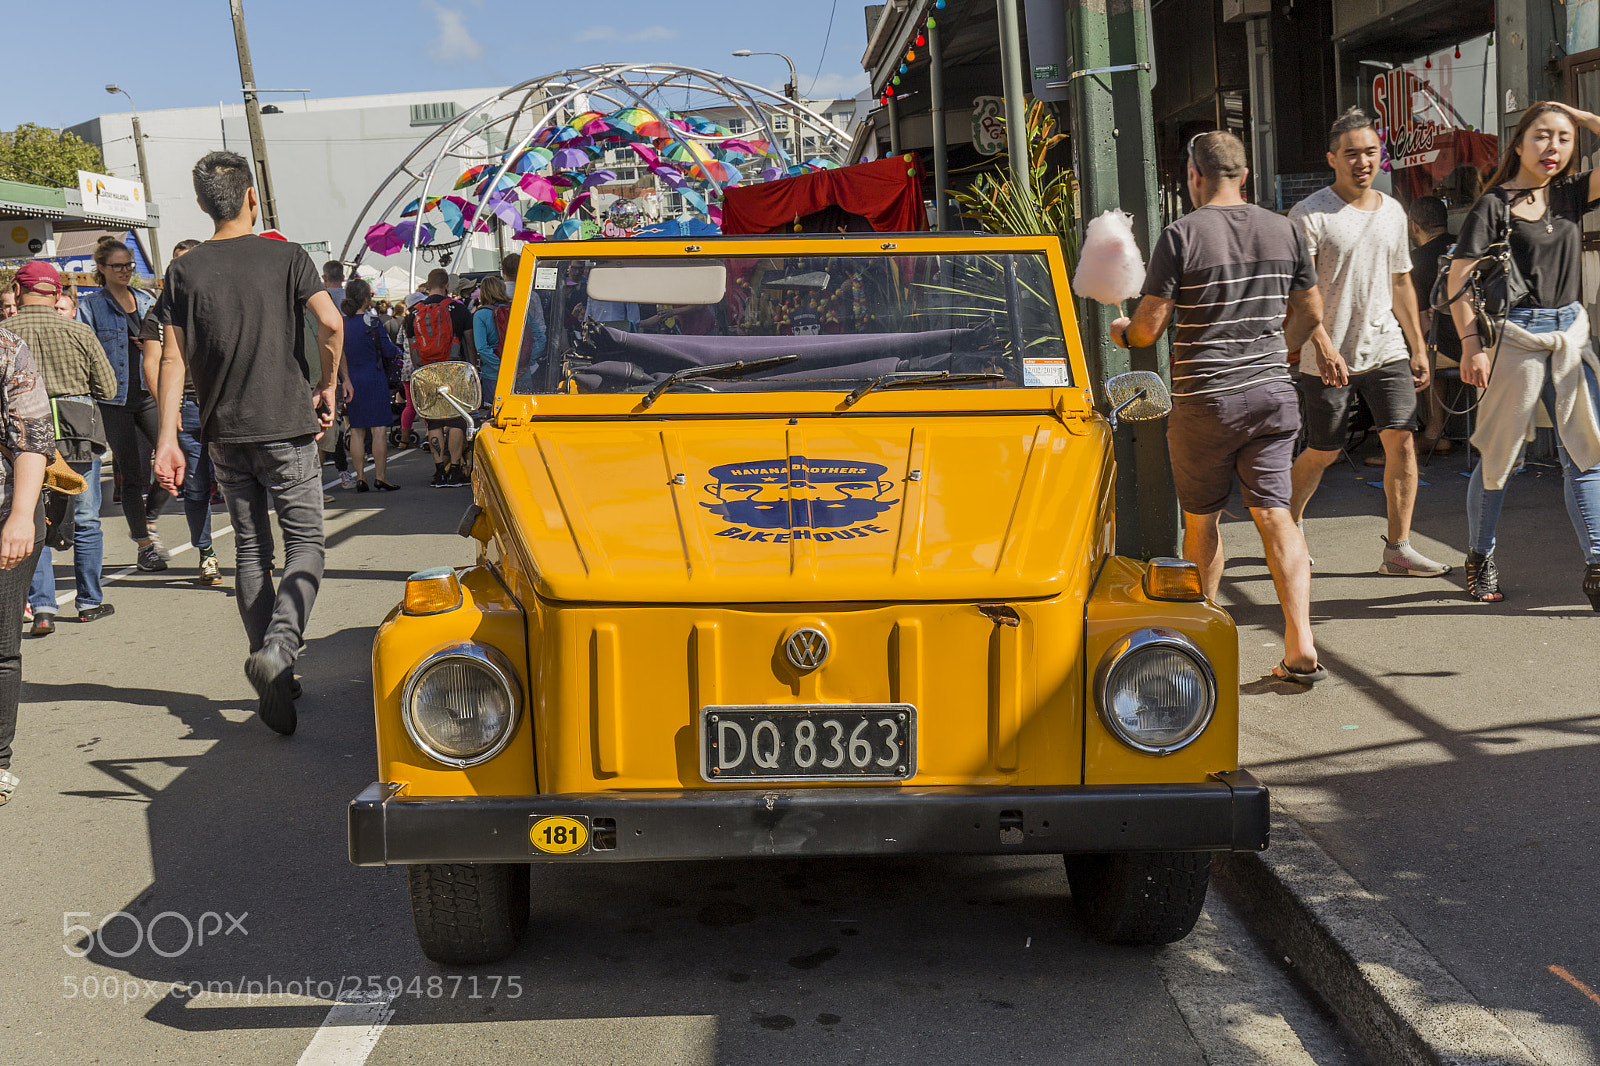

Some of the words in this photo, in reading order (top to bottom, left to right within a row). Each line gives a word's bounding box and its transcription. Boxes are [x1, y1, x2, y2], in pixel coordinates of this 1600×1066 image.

[1395, 123, 1433, 160] Cuts
[1404, 154, 1426, 165] INC
[731, 467, 789, 476] HAVANA
[791, 463, 867, 474] BROTHERS
[714, 524, 890, 544] BAKEHOUSE
[718, 720, 780, 769] DQ
[794, 718, 900, 768] 8363
[543, 826, 577, 844] 181
